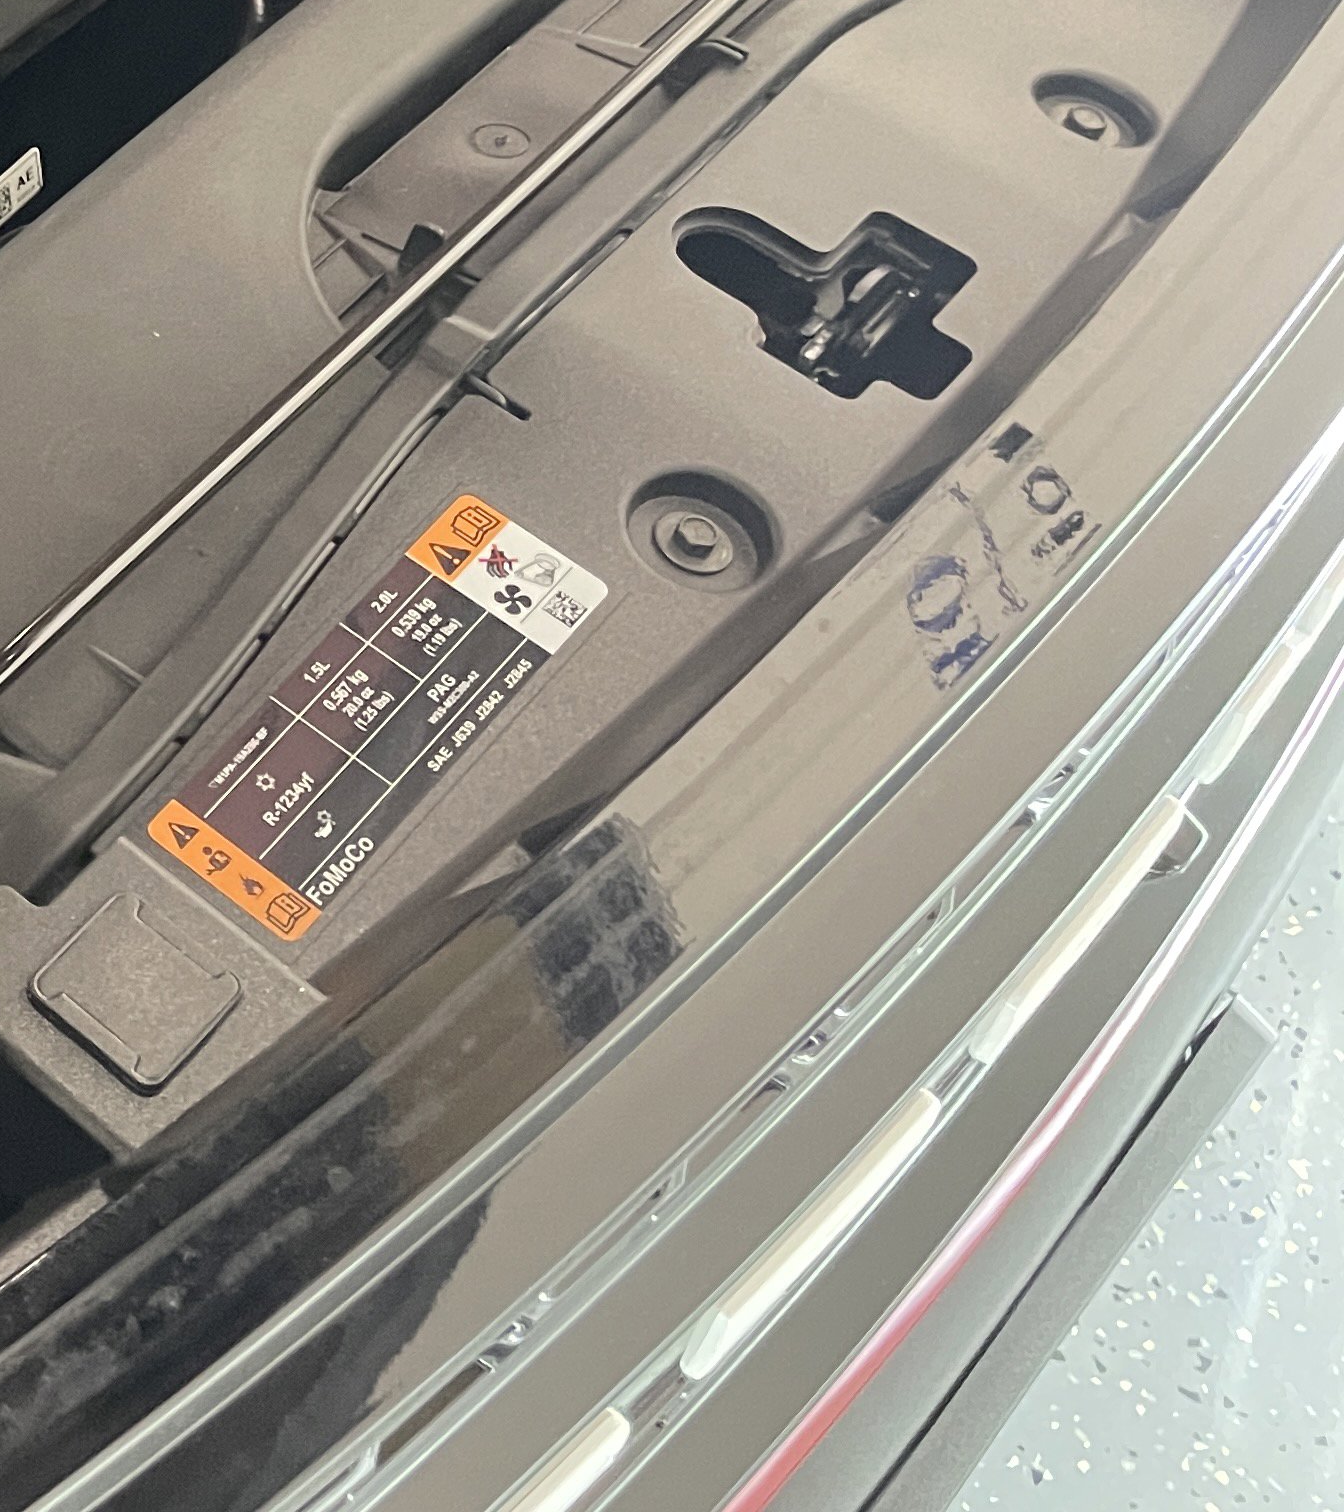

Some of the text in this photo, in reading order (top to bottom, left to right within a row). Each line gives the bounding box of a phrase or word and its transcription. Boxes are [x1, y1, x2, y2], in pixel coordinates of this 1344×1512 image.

[370, 590, 399, 614] 2.0L
[391, 597, 437, 638] 0.539 kg
[303, 661, 331, 684] 1.5L
[322, 669, 369, 711] 0.567 kg
[426, 673, 456, 703] PAG
[427, 658, 533, 772] SAE J639 J2842 J2845
[262, 771, 315, 827] R-1234yf
[305, 837, 374, 906] FoMoCo
